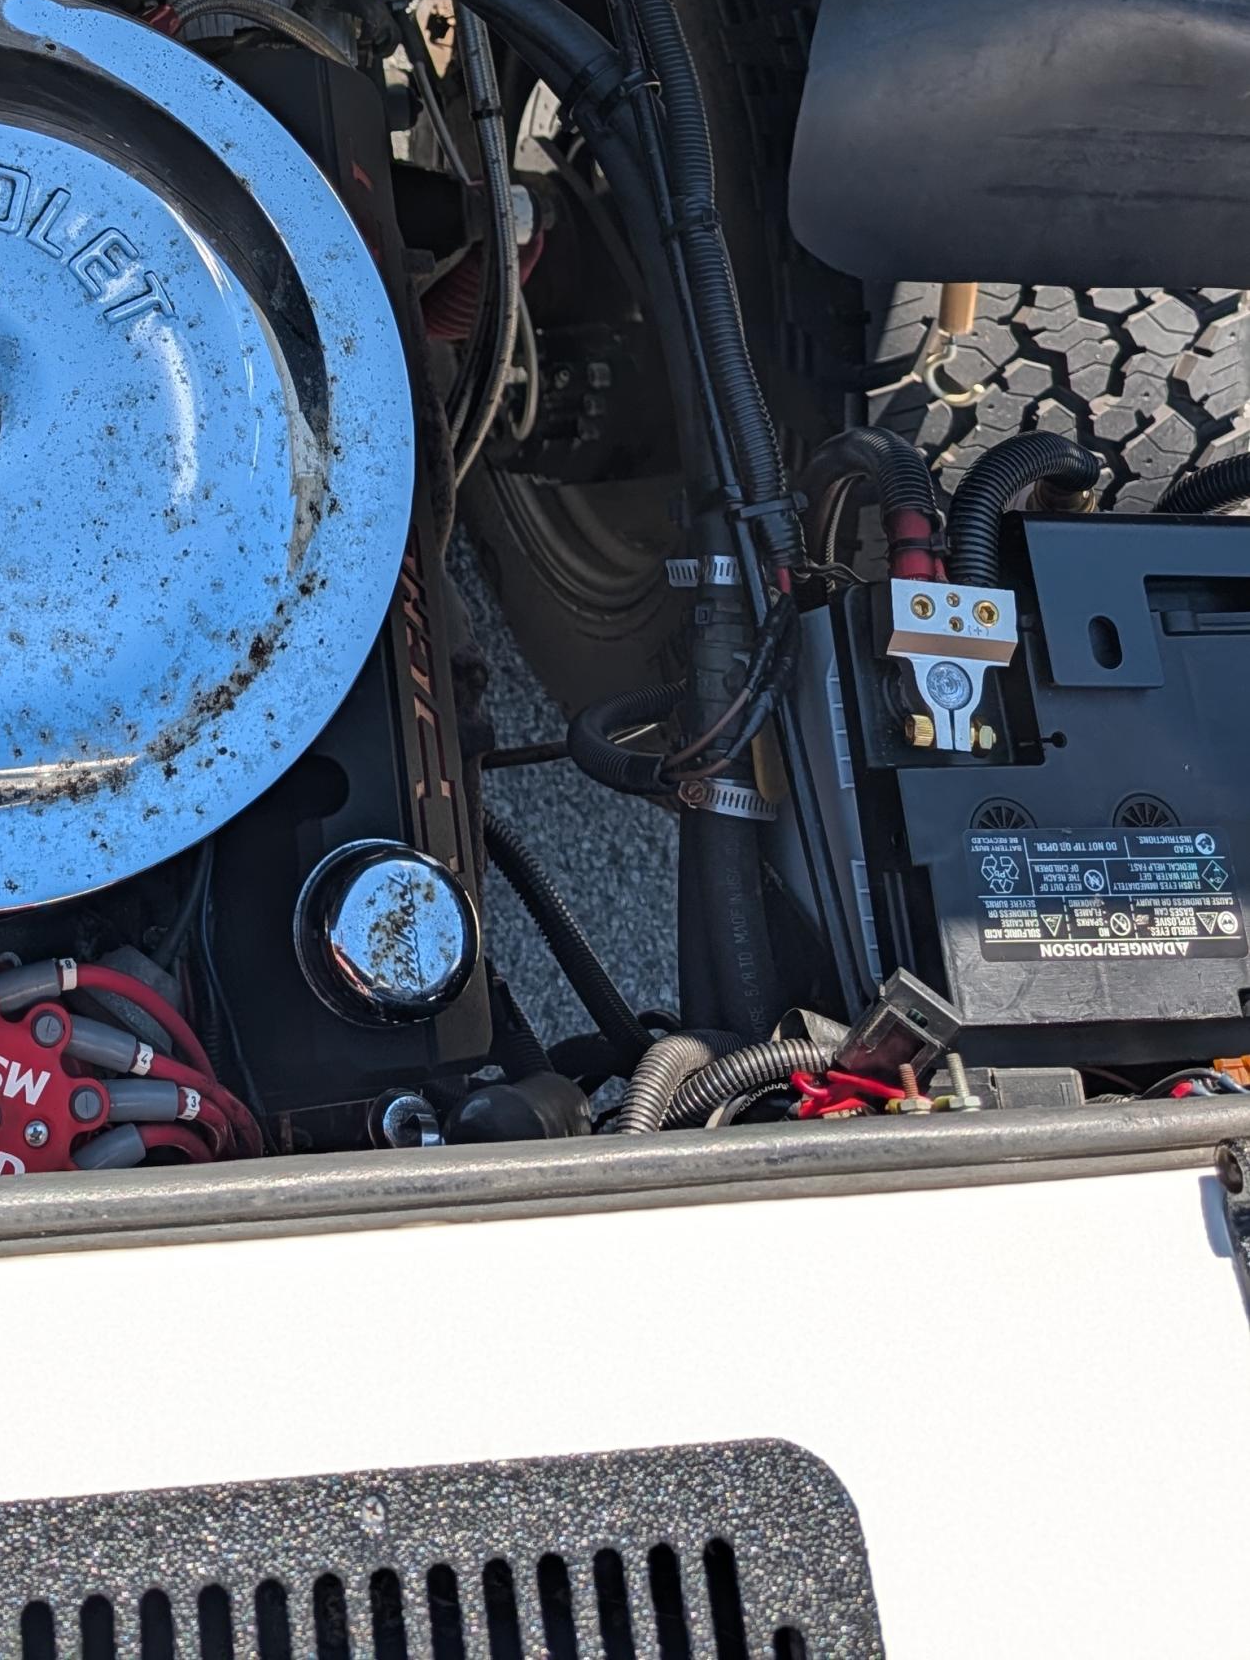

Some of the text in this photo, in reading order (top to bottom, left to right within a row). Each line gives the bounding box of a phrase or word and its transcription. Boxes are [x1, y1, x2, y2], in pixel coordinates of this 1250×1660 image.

[1060, 842, 1071, 851] OR
[1074, 843, 1086, 851] TIP
[1105, 842, 1117, 850] DO
[1174, 845, 1194, 853] READ
[1148, 863, 1165, 871] HELP
[1167, 863, 1197, 871] MEDICAL
[1043, 874, 1066, 882] REACH
[1181, 872, 1199, 880] WITH
[1039, 883, 1049, 891] OF
[1050, 883, 1063, 891] OUT
[1113, 881, 1200, 890] FLUSH EYES IMMEDIATELY
[1009, 900, 1035, 908] SEVERE
[1161, 898, 1171, 906] OR
[1172, 897, 1210, 906] BLINDNESS
[1211, 897, 1233, 905] CAUSE
[1154, 908, 1194, 916] GASES CAN
[1154, 917, 1196, 926] EXPLOSIVE
[388, 870, 422, 990] Edelbrock
[984, 929, 1040, 938] SULFURIC ACID
[1099, 927, 1109, 936] NO
[1171, 926, 1198, 936] SHIELD
[1039, 942, 1176, 957] DANGER/POISON
[140, 1052, 149, 1065] 4
[189, 1095, 198, 1108] 3
